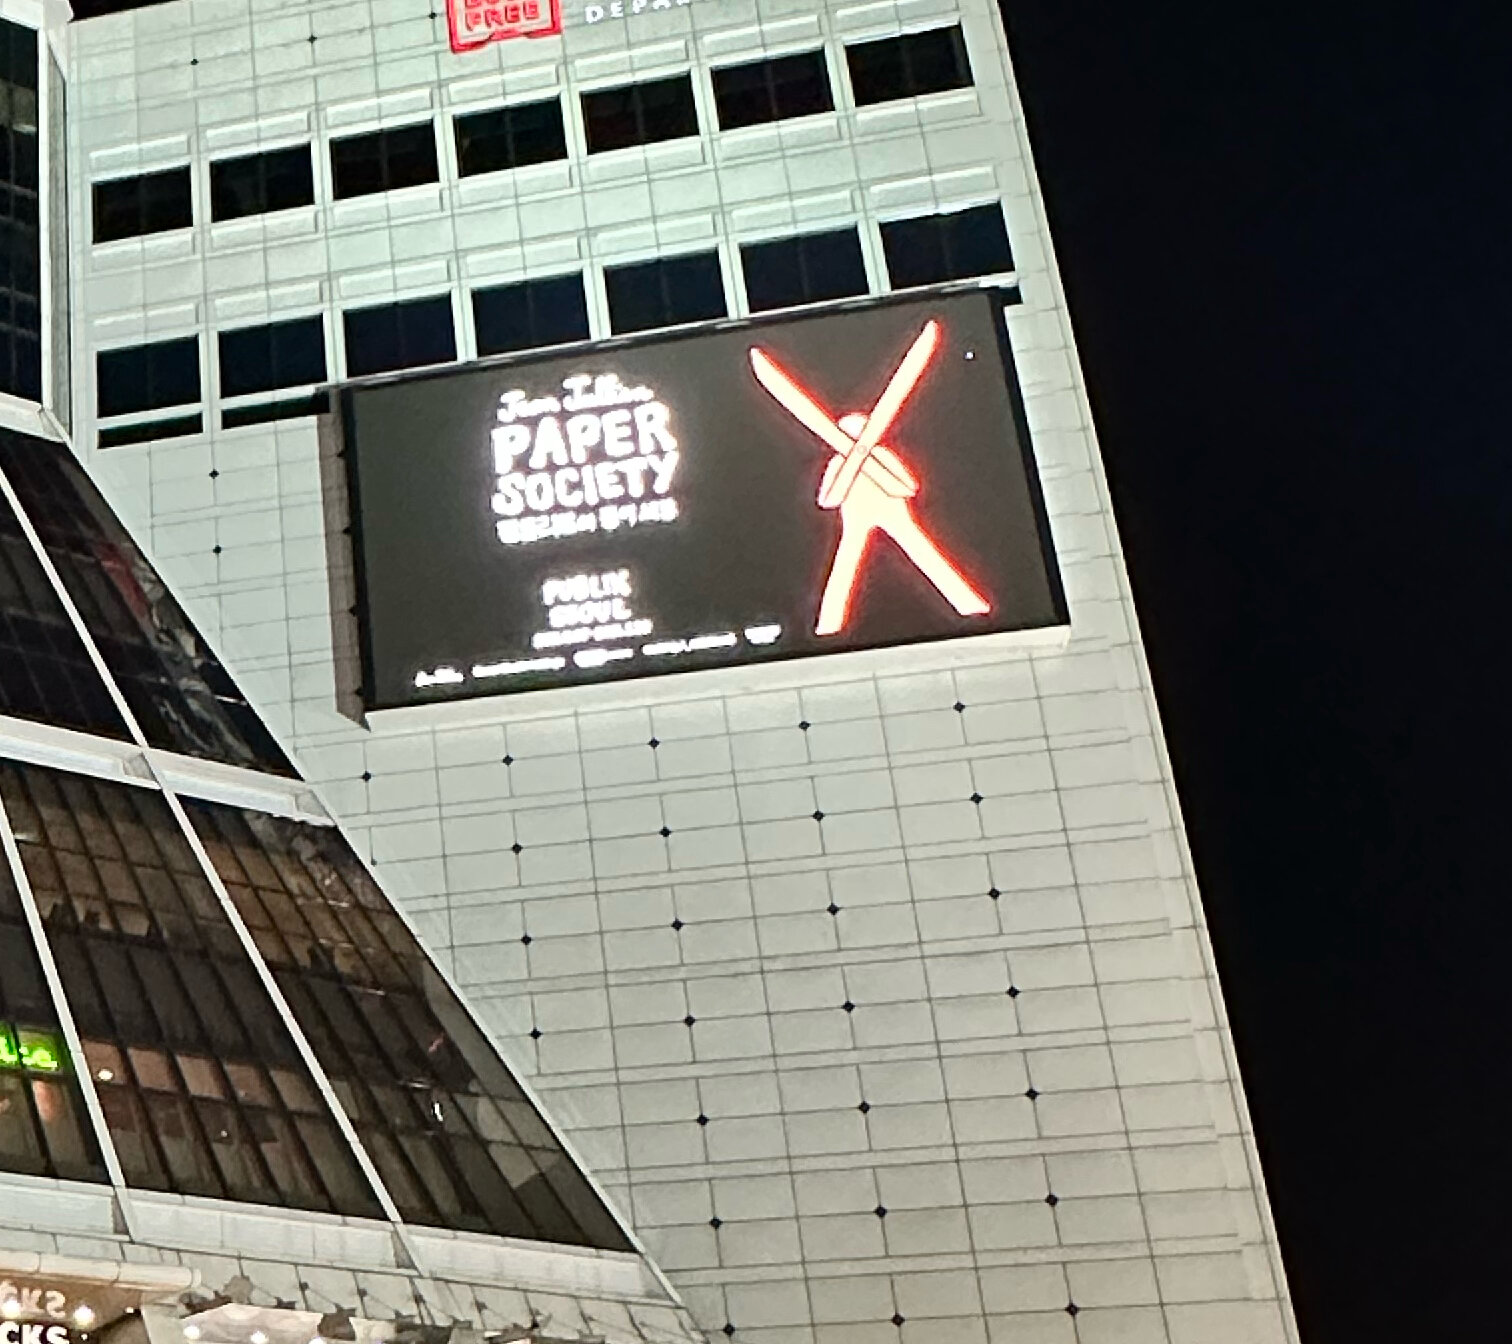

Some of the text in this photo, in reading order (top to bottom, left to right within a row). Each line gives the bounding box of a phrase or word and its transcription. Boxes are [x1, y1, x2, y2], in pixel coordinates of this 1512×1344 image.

[465, 1, 540, 32] FREE
[491, 401, 678, 475] PAPER
[491, 451, 680, 515] SOCIETY
